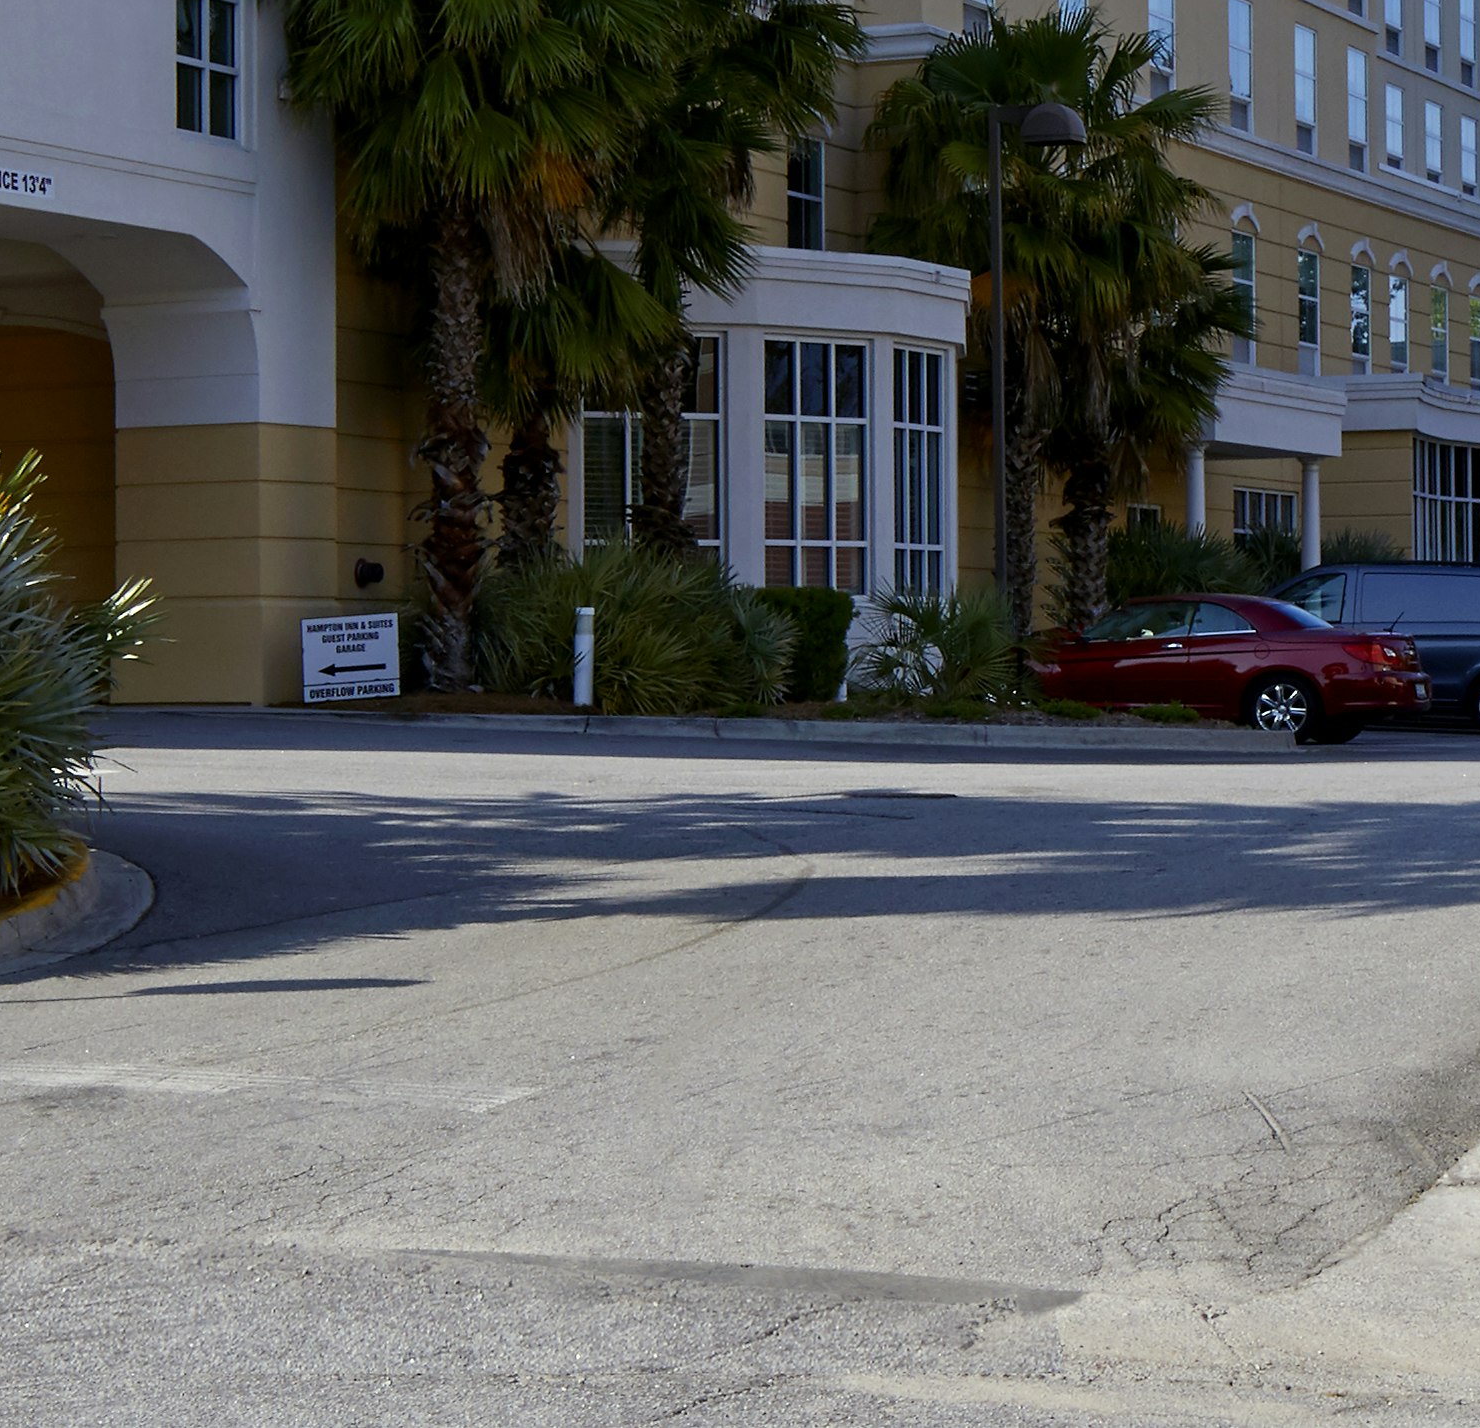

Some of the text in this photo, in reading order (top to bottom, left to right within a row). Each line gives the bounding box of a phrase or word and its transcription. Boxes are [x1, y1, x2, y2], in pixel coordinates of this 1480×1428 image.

[306, 619, 394, 633] HAMPTON INN & SUITES
[322, 631, 379, 644] GUEST PARKING
[336, 644, 366, 654] GARAGE
[309, 683, 395, 699] OVERFLOW PARKING
